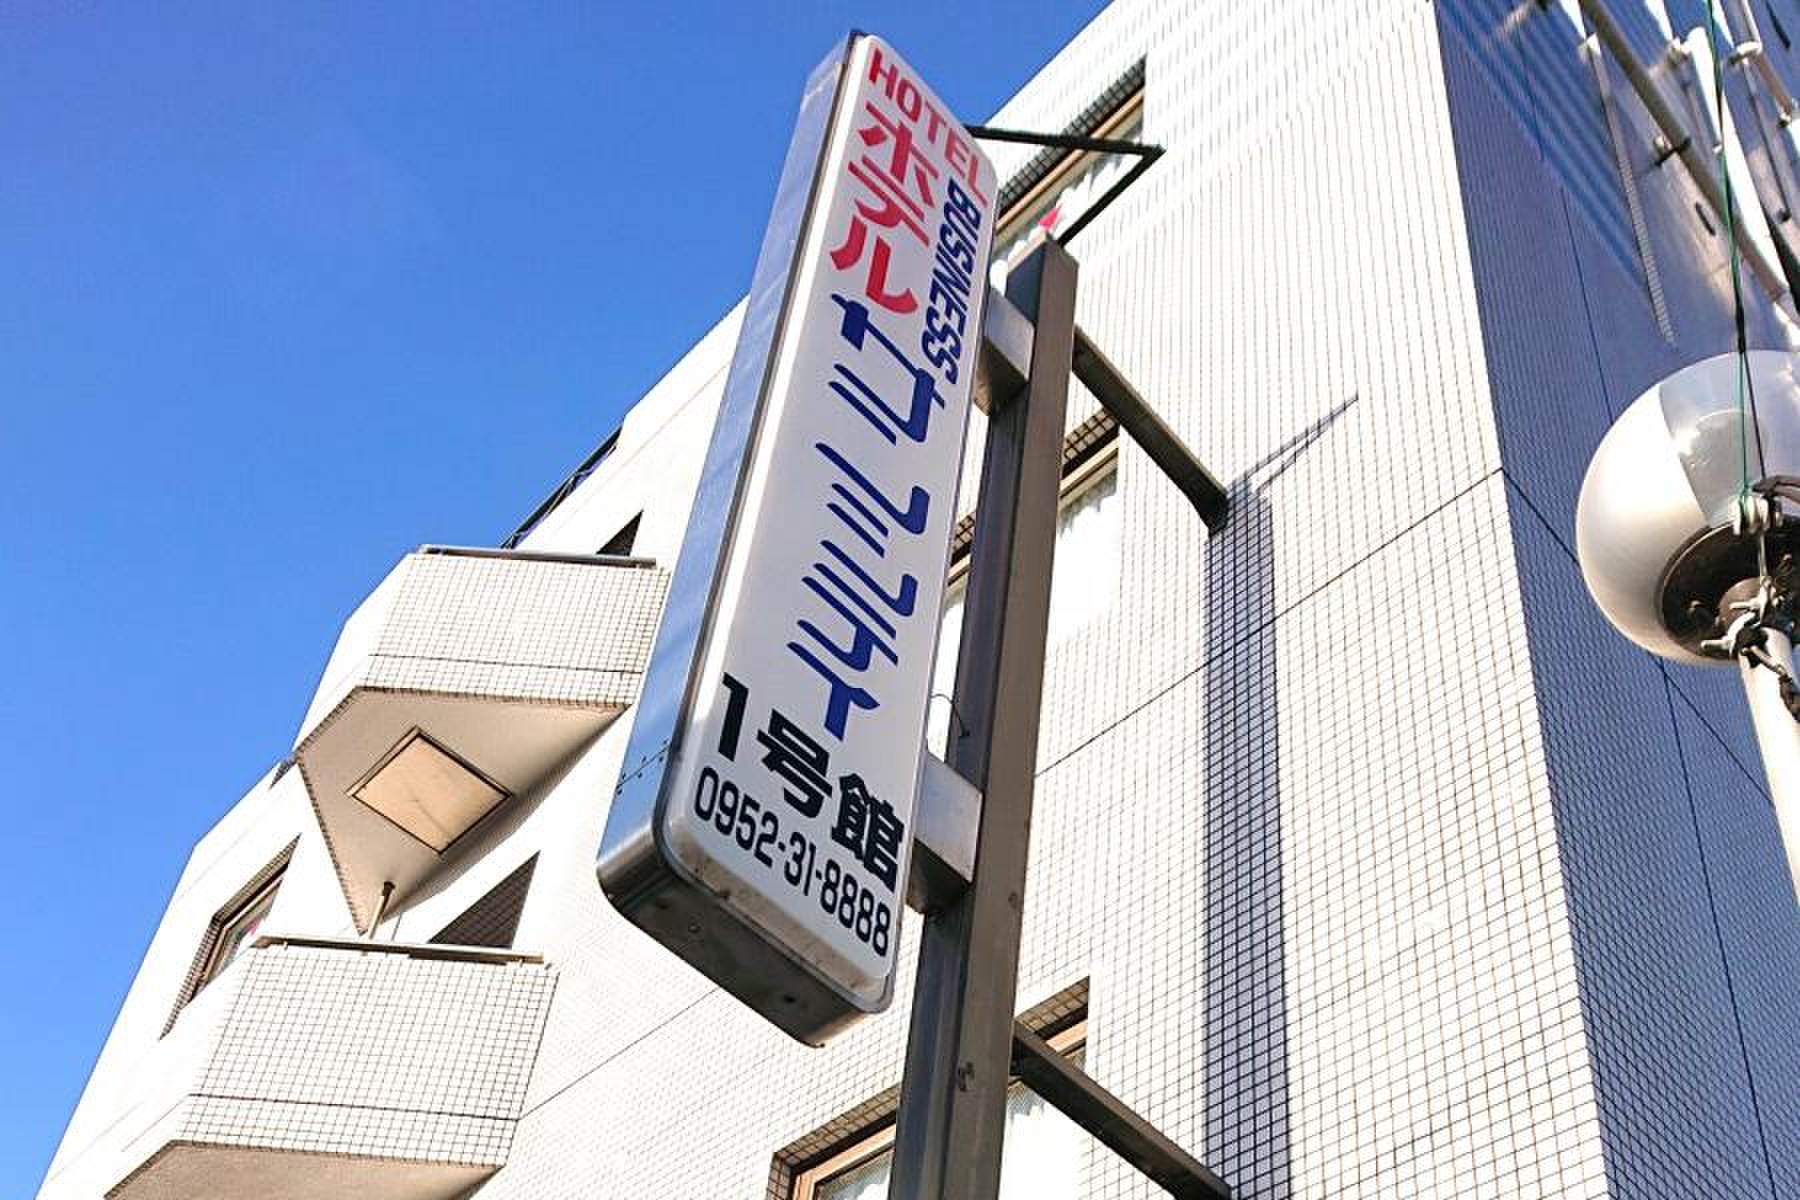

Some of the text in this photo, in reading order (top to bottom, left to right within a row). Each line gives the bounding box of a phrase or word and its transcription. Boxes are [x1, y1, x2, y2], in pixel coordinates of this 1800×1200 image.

[829, 102, 940, 315] ホテル
[868, 48, 988, 207] HOTEL
[921, 177, 982, 386] BUSINESS
[694, 766, 891, 957] 0952-31-8888
[718, 672, 904, 893] 1号館
